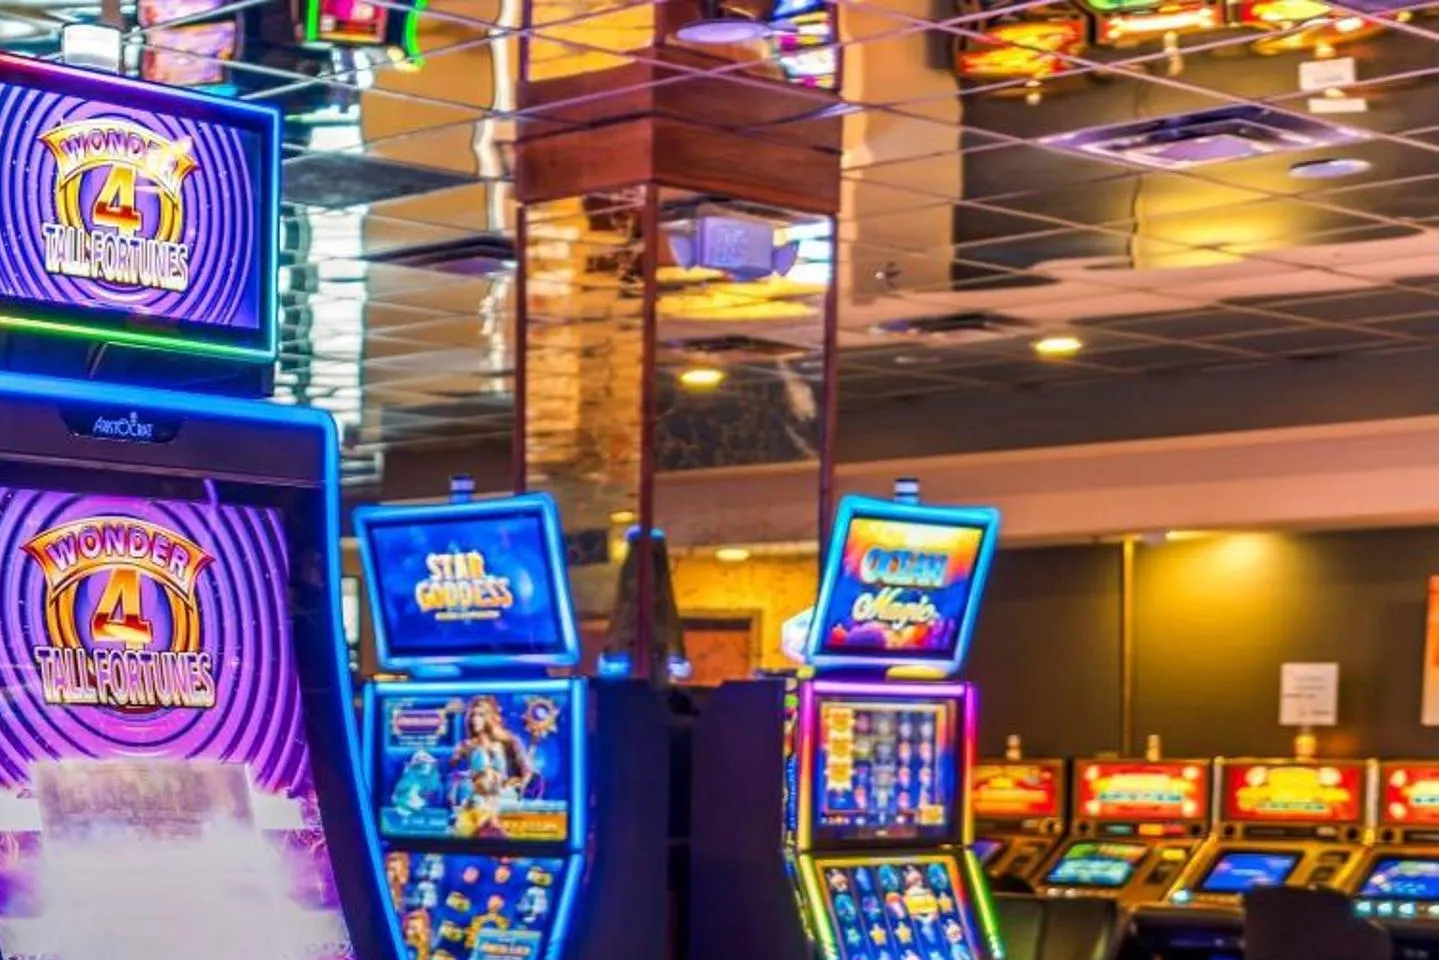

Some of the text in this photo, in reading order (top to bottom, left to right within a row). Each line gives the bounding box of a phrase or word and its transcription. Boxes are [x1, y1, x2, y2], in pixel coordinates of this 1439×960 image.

[60, 128, 178, 186] WOND
[92, 166, 142, 236] 4
[43, 222, 189, 292] TALL FORTUNES
[46, 526, 190, 580] WONDER
[426, 551, 485, 580] STAR
[91, 568, 152, 650] 4
[416, 575, 513, 612] GODDESS
[35, 647, 216, 708] TALL FORTUNES
